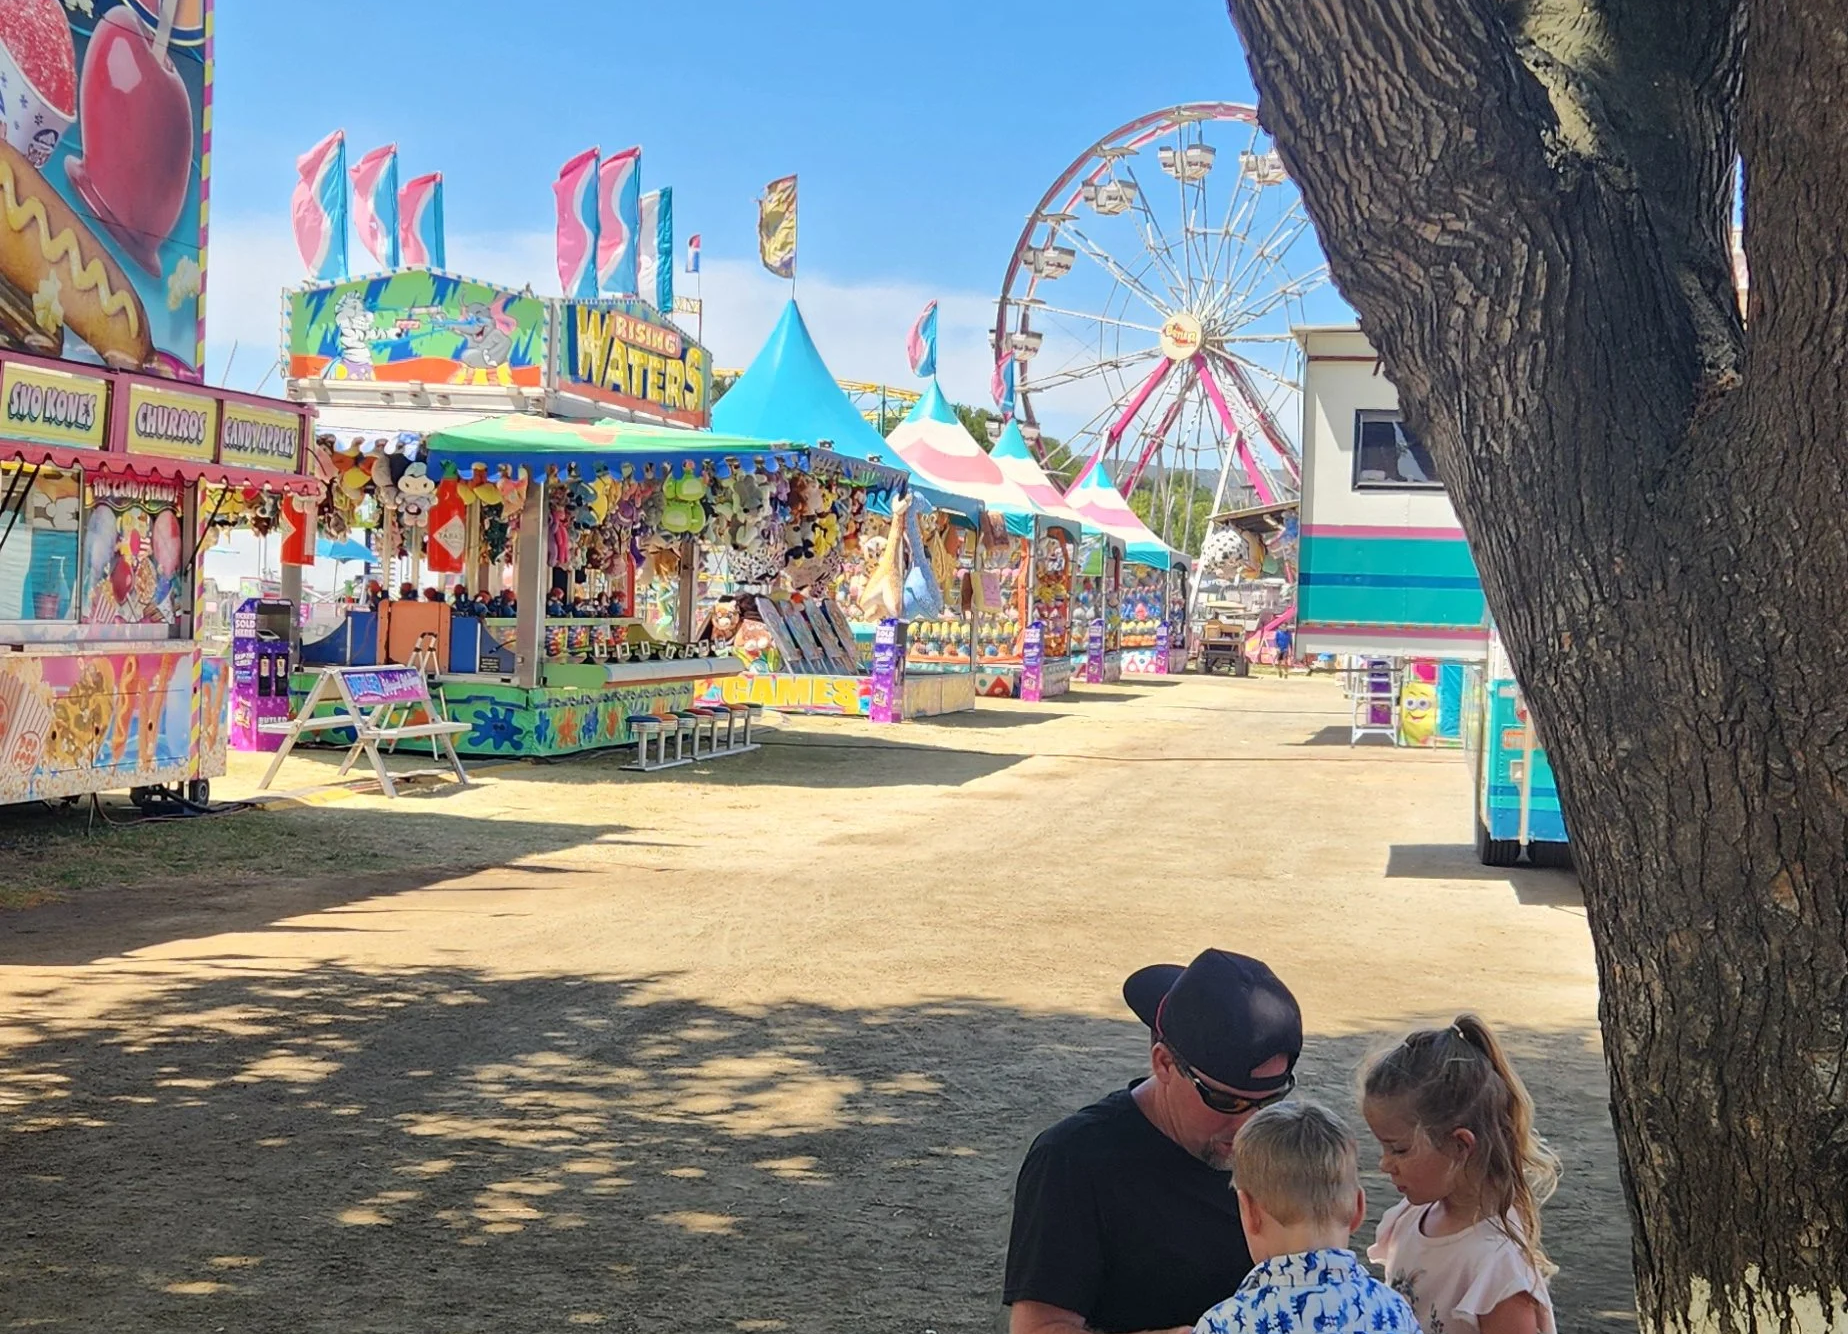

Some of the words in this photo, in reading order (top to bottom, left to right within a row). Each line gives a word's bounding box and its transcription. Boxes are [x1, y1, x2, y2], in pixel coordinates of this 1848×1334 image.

[615, 314, 676, 354] RISING
[576, 304, 704, 411] WATERS
[8, 381, 43, 422] SNO
[43, 386, 97, 431] KONES
[135, 402, 207, 445] CHURROS
[223, 417, 257, 453] CANDY
[257, 422, 297, 459] APPLES
[234, 620, 256, 628] SOLD
[721, 676, 859, 709] GAMES
